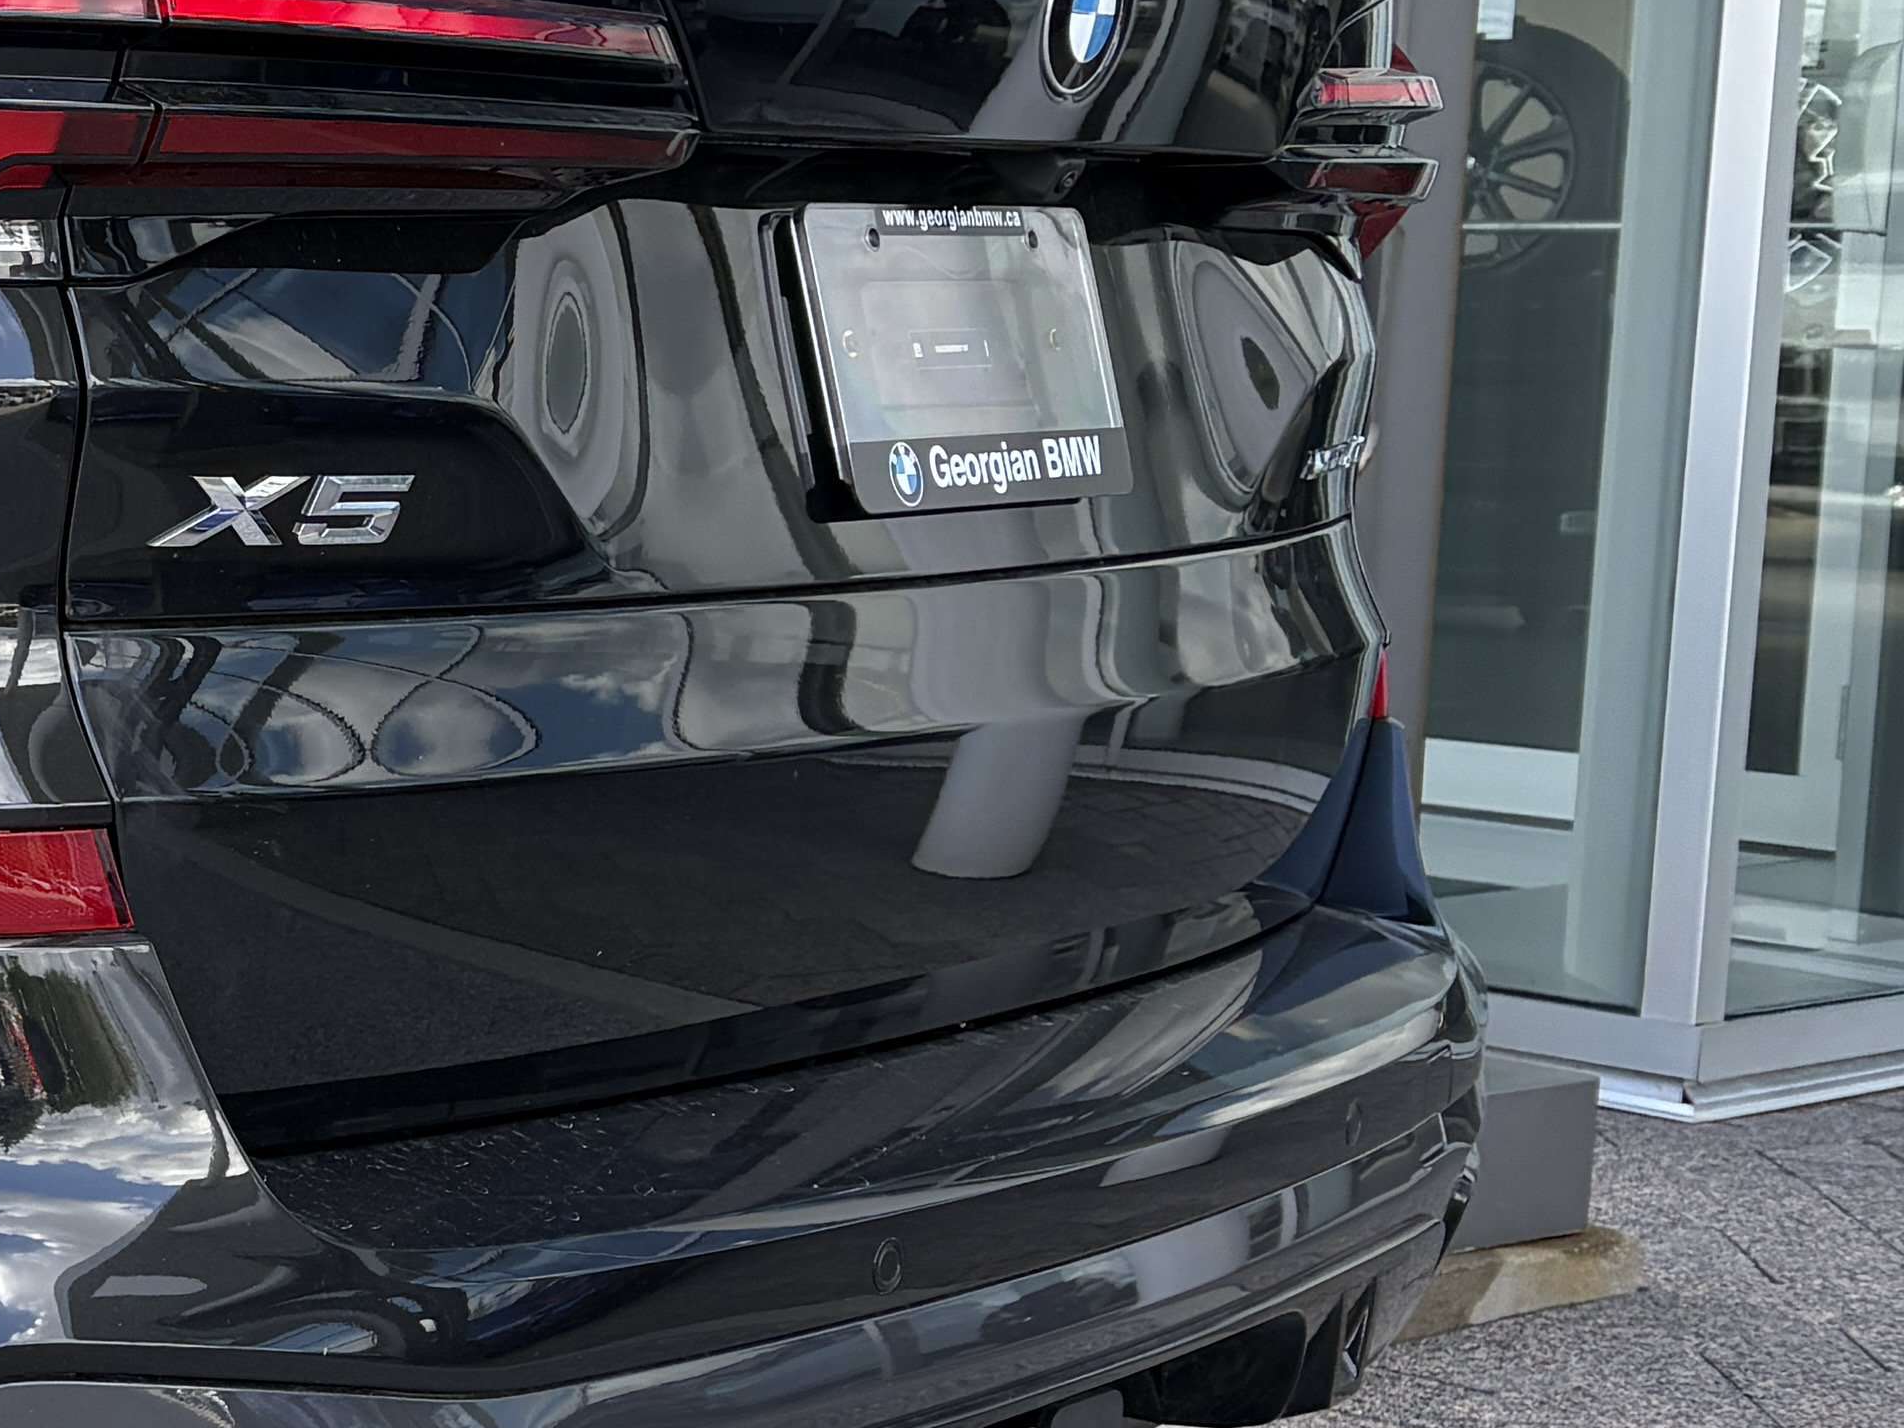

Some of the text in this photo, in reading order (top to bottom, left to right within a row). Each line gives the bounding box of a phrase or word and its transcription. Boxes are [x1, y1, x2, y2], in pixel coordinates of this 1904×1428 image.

[881, 206, 1022, 232] www.georgianbmw.ca
[929, 441, 1041, 494] Georgian
[1041, 435, 1102, 479] BMW
[145, 474, 416, 547] X5
